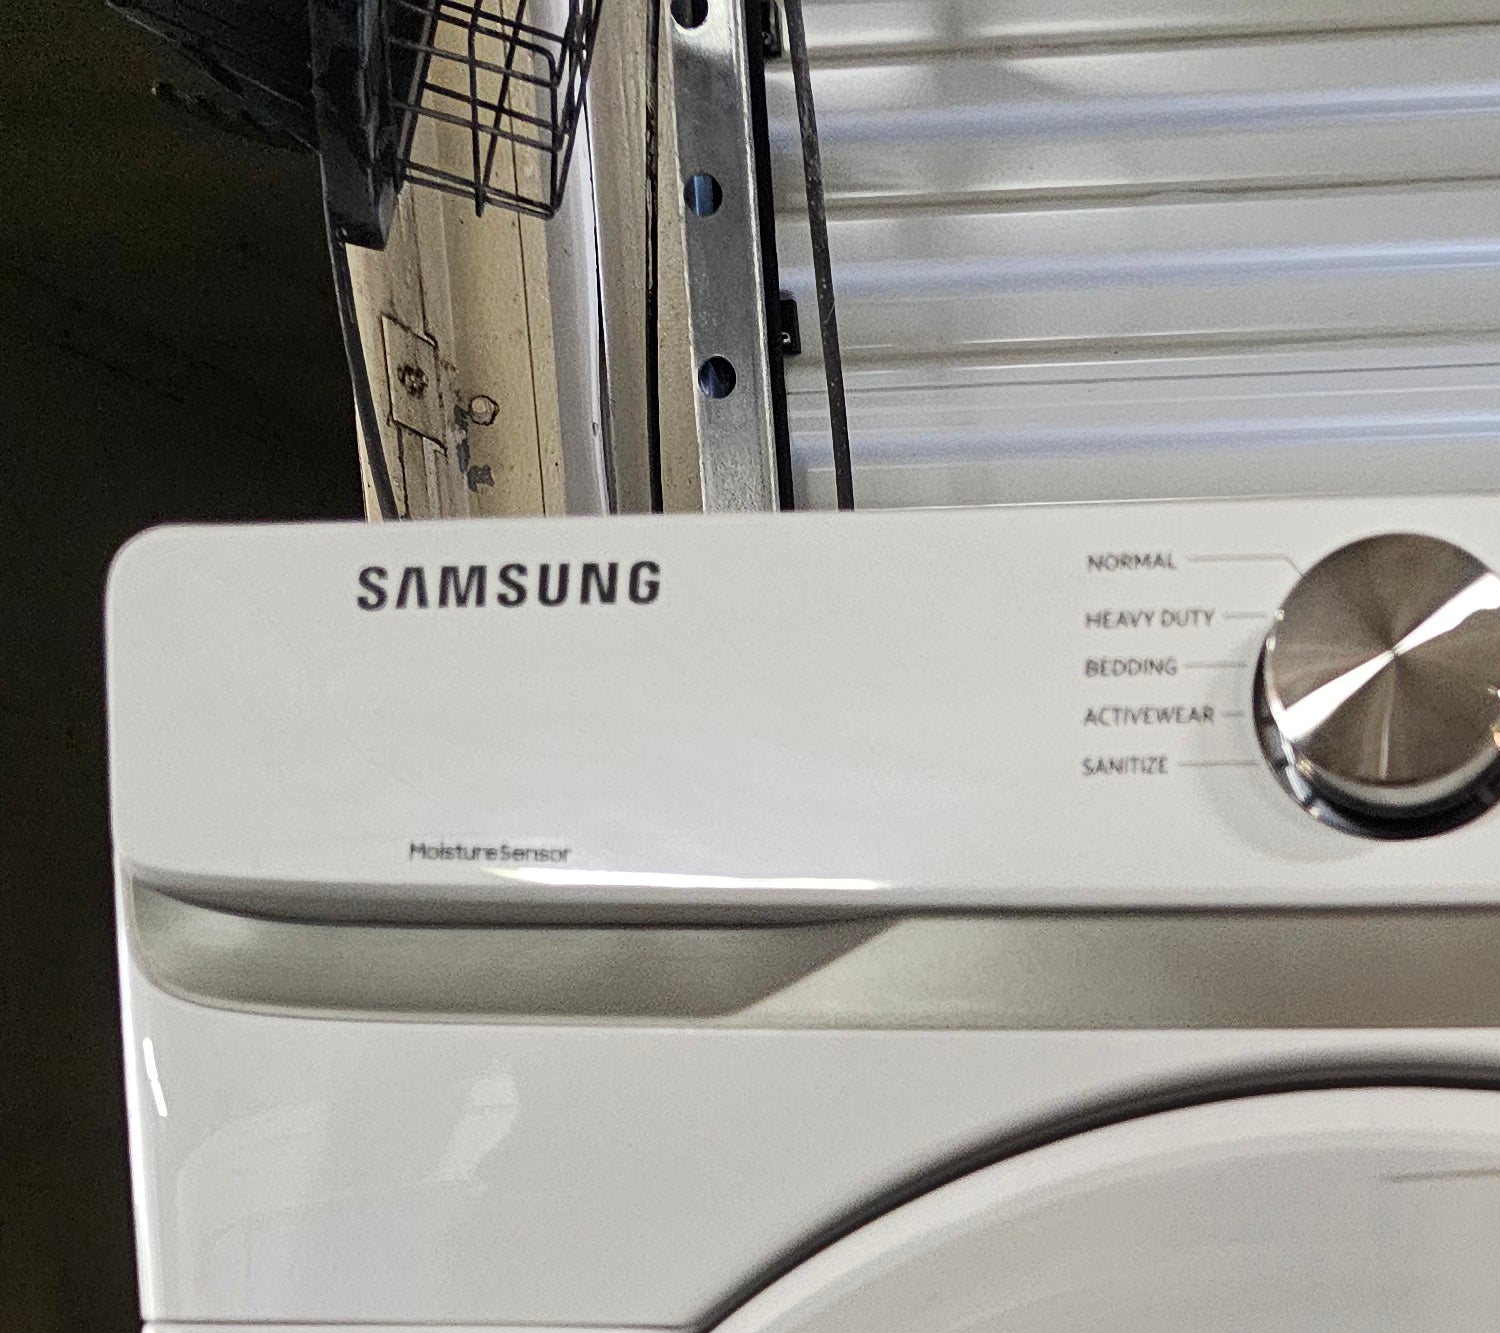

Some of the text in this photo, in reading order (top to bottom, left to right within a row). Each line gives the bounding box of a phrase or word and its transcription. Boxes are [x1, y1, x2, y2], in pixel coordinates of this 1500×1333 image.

[1088, 553, 1176, 571] NORMAL
[357, 560, 661, 611] SAMSUNG
[1086, 607, 1215, 629] HEAVY DUTY
[1084, 658, 1177, 677] BEDDING
[1084, 705, 1214, 726] ACTIVEWEAR
[1082, 756, 1168, 775] SANITIZE
[409, 840, 572, 862] Moisture Sensor
